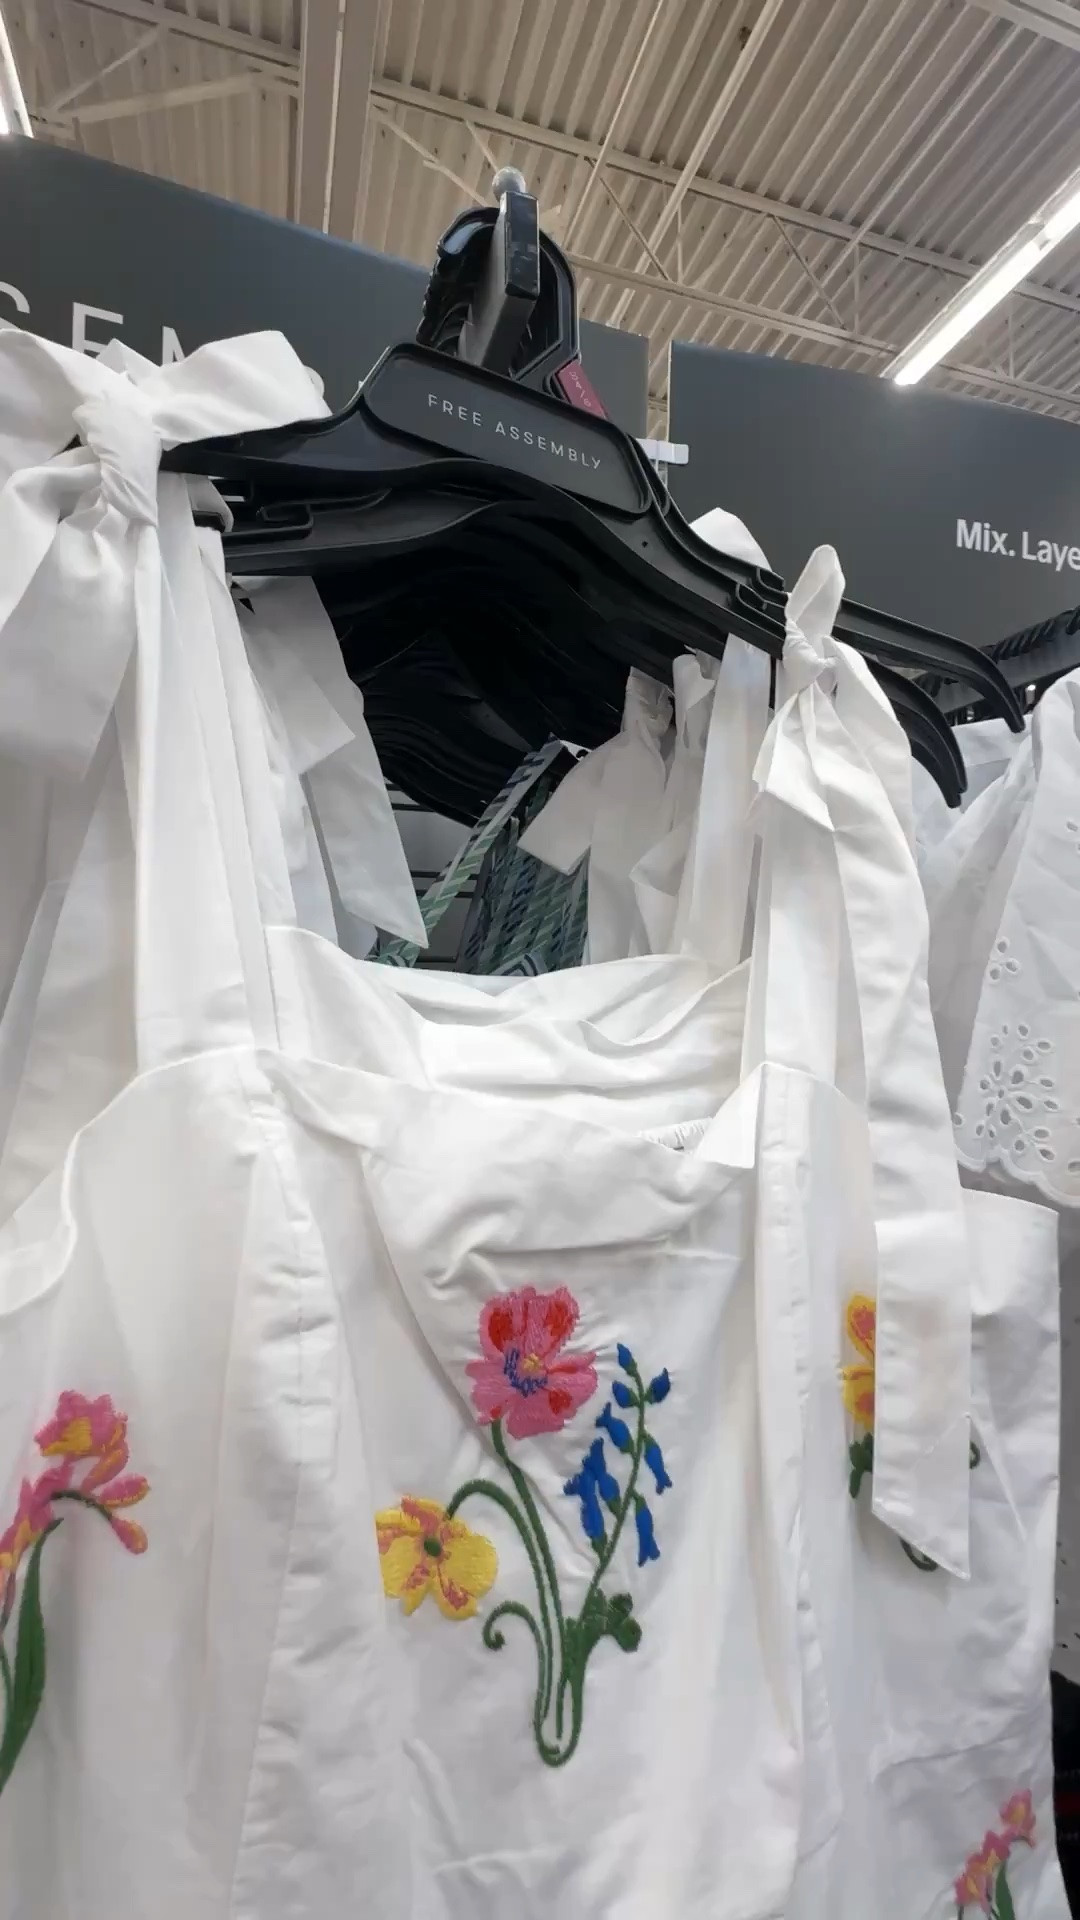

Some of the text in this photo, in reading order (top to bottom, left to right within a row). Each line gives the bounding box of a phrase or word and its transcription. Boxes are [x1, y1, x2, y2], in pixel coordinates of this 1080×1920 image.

[427, 393, 601, 470] FREE ASSEMBLY
[956, 518, 1016, 557] Mix.
